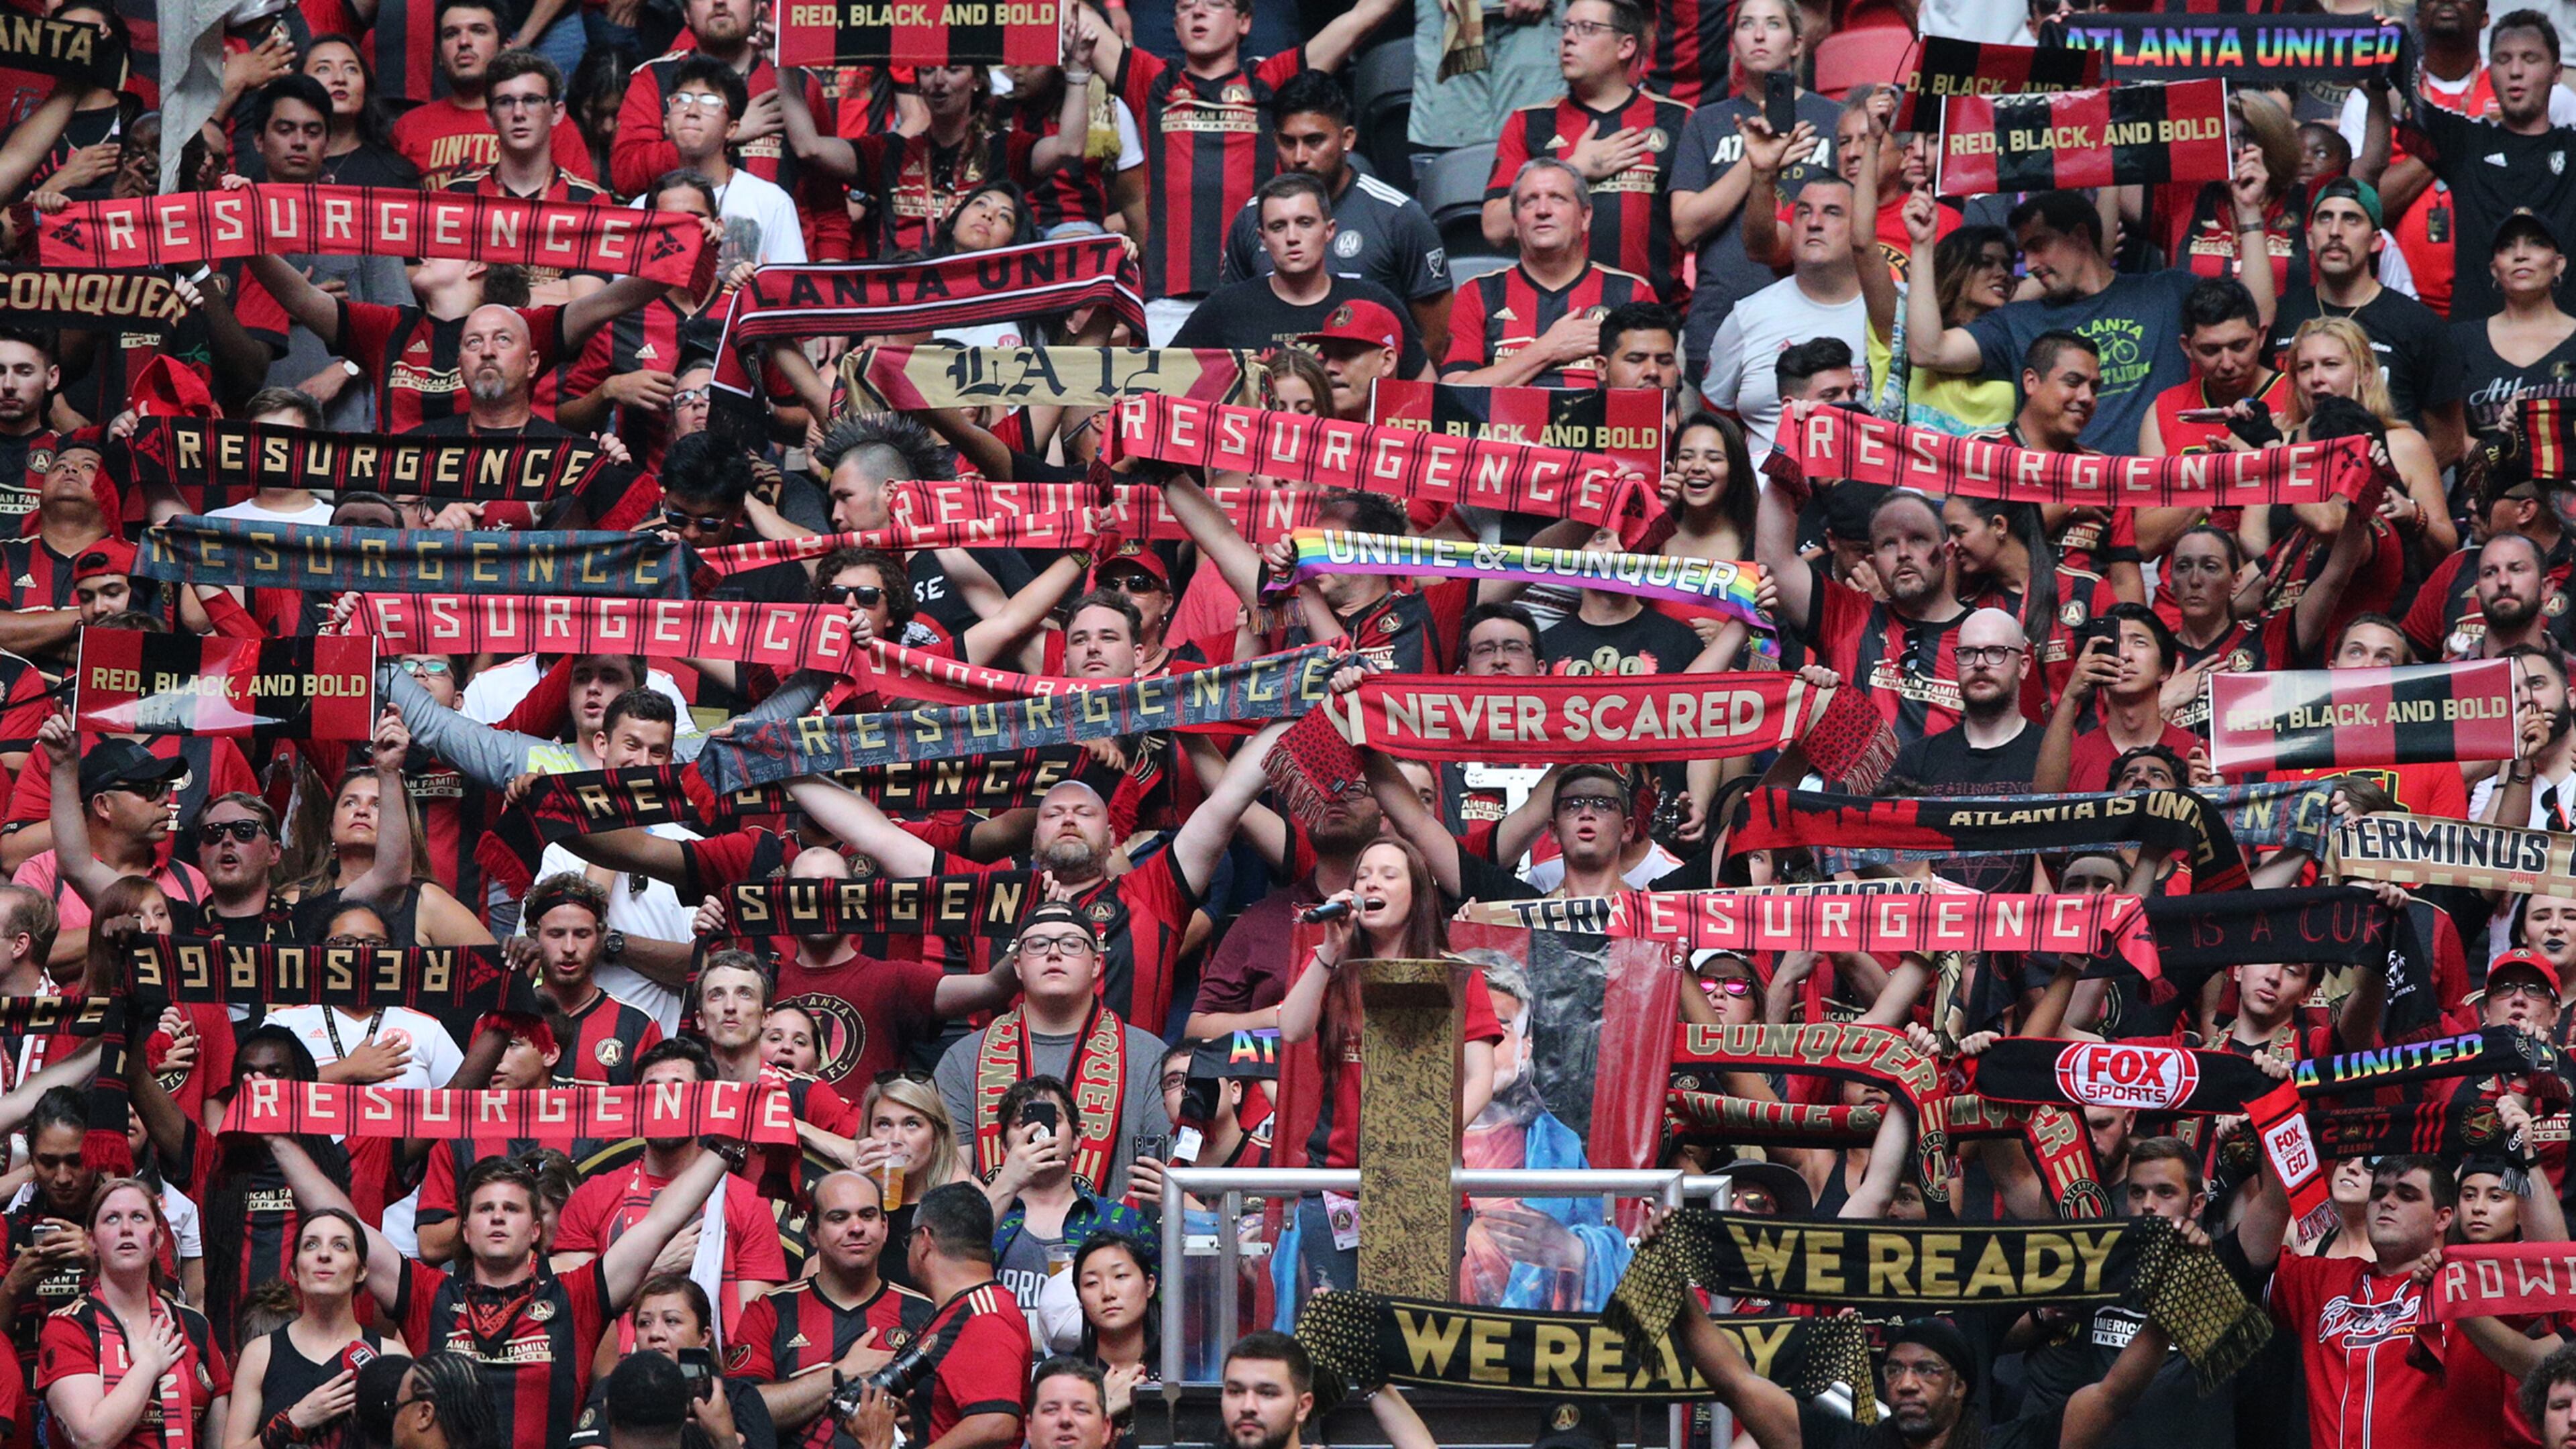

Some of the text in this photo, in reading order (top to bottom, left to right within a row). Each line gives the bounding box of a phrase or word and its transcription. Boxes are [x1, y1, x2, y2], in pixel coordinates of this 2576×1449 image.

[791, 3, 1055, 30] RED, BLACK, AND BOLD
[2066, 25, 2402, 67] ATLANTA UNITED
[1161, 109, 1256, 122] AMERICAN FAMILY
[1950, 117, 2220, 156] RED, BLACK, AND BOLD
[105, 198, 633, 260] RESURGENCE
[946, 346, 1161, 397] LA 12
[1120, 398, 1609, 511] RESURGENCE
[1540, 425, 1587, 448] AND
[1595, 427, 1658, 449] BOLD
[1807, 414, 2316, 490] RESURGENCE
[177, 429, 594, 487] RESURGENCE
[152, 525, 659, 585] RESURGENCE
[1323, 528, 1739, 602] UNITE & CONQUER
[92, 667, 366, 700] RED, BLACK, AND BOLD
[797, 657, 1330, 755] RESURGENCE
[1382, 690, 1765, 743] NEVER SCARED
[2226, 696, 2507, 732] RED, BLACK, AND BOLD
[422, 776, 462, 788] FAMILY
[1950, 799, 2094, 826] ATLANTA
[2106, 797, 2136, 817] IS
[2339, 815, 2549, 874] TERMINUS
[2509, 873, 2536, 886] 2018
[739, 882, 1023, 924] SURGEN
[1686, 1024, 1938, 1098] CONQUER
[2088, 1046, 2168, 1087] FOX
[2334, 1033, 2483, 1083] UNITED
[252, 1080, 790, 1128] RESURGENCE
[1683, 1092, 1833, 1131] UNITE
[2085, 1084, 2166, 1104] SPORTS
[2275, 1126, 2303, 1153] FOX
[2279, 1141, 2306, 1162] SPORTS
[2337, 1142, 2375, 1155] SEASON
[2287, 1152, 2309, 1177] GO
[1727, 1224, 2126, 1297] WE READY
[508, 1340, 551, 1355] FAMILY
[1394, 1309, 1514, 1384] WE
